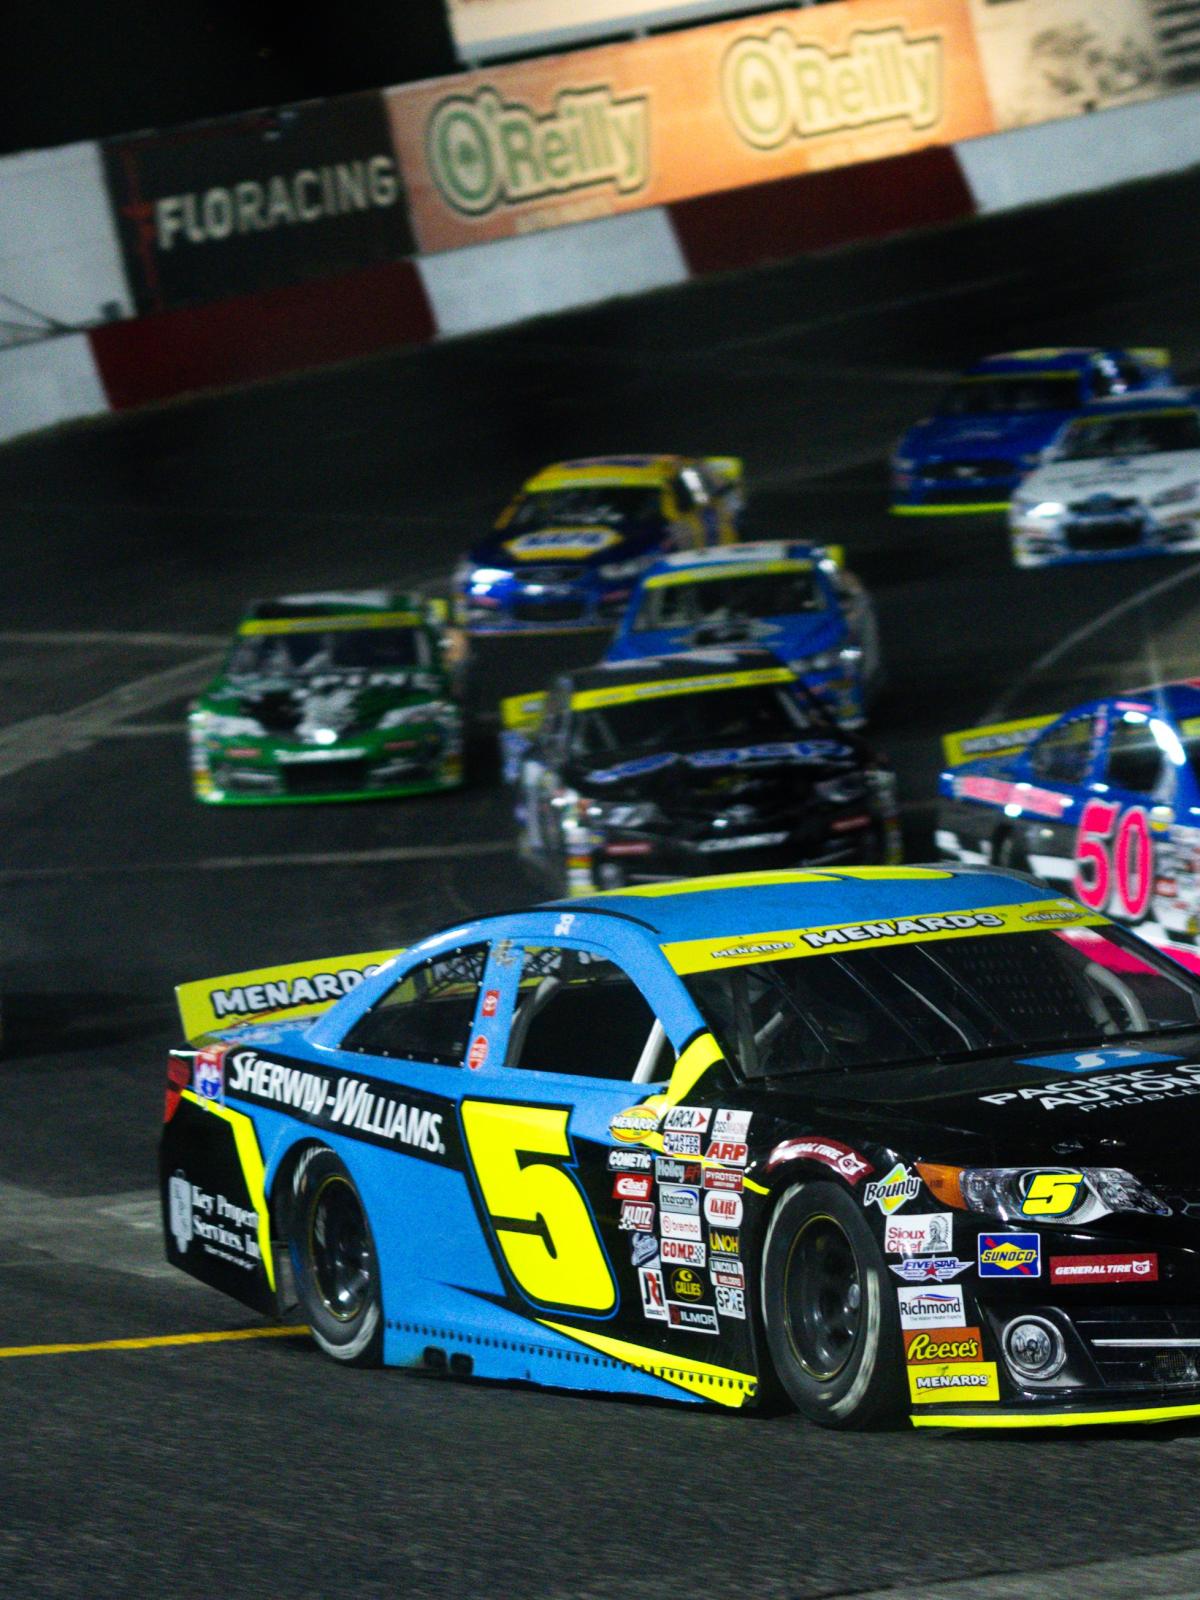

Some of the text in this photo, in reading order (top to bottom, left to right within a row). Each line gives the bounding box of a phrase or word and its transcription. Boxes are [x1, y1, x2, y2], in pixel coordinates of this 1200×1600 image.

[733, 37, 941, 137] O'Reilly
[438, 94, 648, 202] O'Reilly
[154, 154, 398, 250] FLORACING
[1072, 797, 1154, 918] 50
[803, 914, 1002, 948] MENARDS
[711, 942, 795, 960] MENARDS
[979, 1070, 1172, 1105] PACIFIC
[667, 1109, 696, 1128] ARCA
[706, 1141, 745, 1160] ARP
[609, 1151, 651, 1169] COMETIC
[706, 1171, 743, 1182] PYROTECT
[866, 1176, 920, 1201] Bounty
[1021, 1173, 1085, 1216] 5
[460, 1100, 616, 1311] 5
[623, 1206, 653, 1224] KLOTZ
[673, 1220, 700, 1233] brembo
[888, 1227, 925, 1239] Sioux
[662, 1242, 695, 1259] COMP
[710, 1232, 739, 1253] UNOH
[887, 1240, 922, 1252] Chef
[903, 1260, 957, 1270] FIVE STAR
[983, 1250, 1035, 1262] SUNOCO
[1055, 1262, 1105, 1275] GENERAL
[1107, 1263, 1131, 1274] TIRE
[675, 1280, 702, 1296] CALLIES
[900, 1298, 961, 1315] Richmond
[680, 1312, 716, 1326] ILMOR
[907, 1334, 978, 1360] Reese's
[917, 1374, 989, 1389] MENARDS
